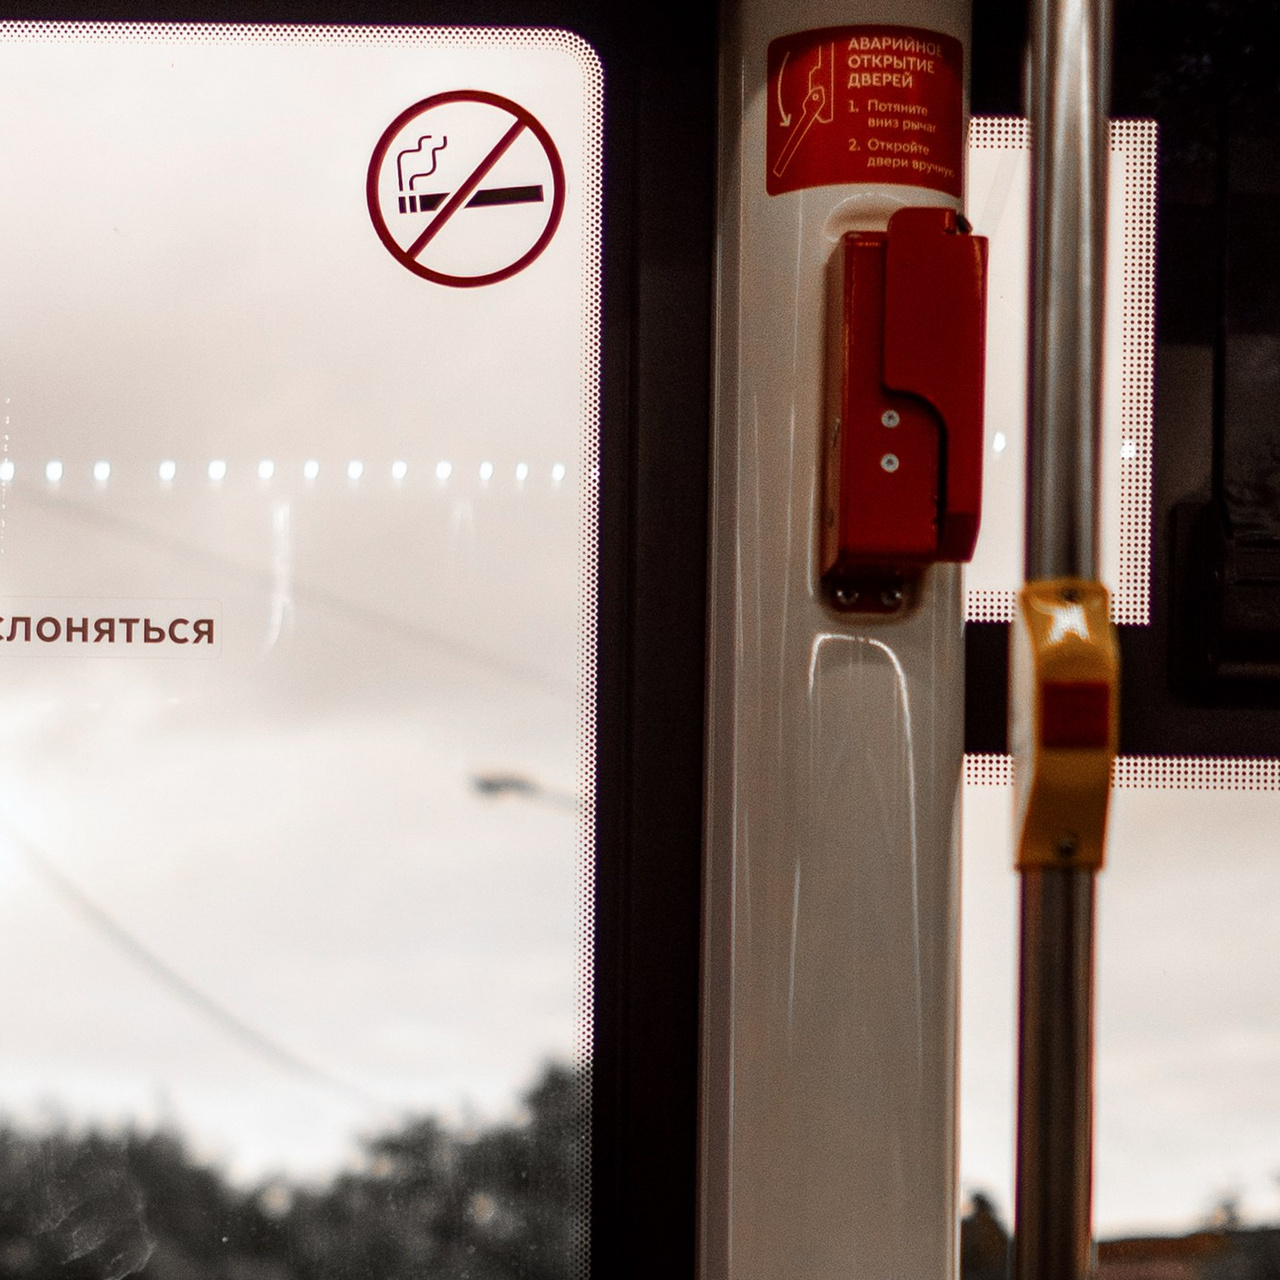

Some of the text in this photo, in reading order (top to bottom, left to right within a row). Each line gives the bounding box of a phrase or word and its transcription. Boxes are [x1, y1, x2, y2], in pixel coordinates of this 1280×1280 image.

[848, 37, 941, 57] АВАРИЙНОЕ
[848, 55, 934, 73] ОТКРЫТИЕ
[848, 72, 913, 89] ДВЕРЕЙ
[849, 100, 928, 116] 1. Потяните
[868, 118, 936, 133] вниз рычаг
[849, 139, 929, 155] 2. Откройте
[867, 157, 908, 167] двери
